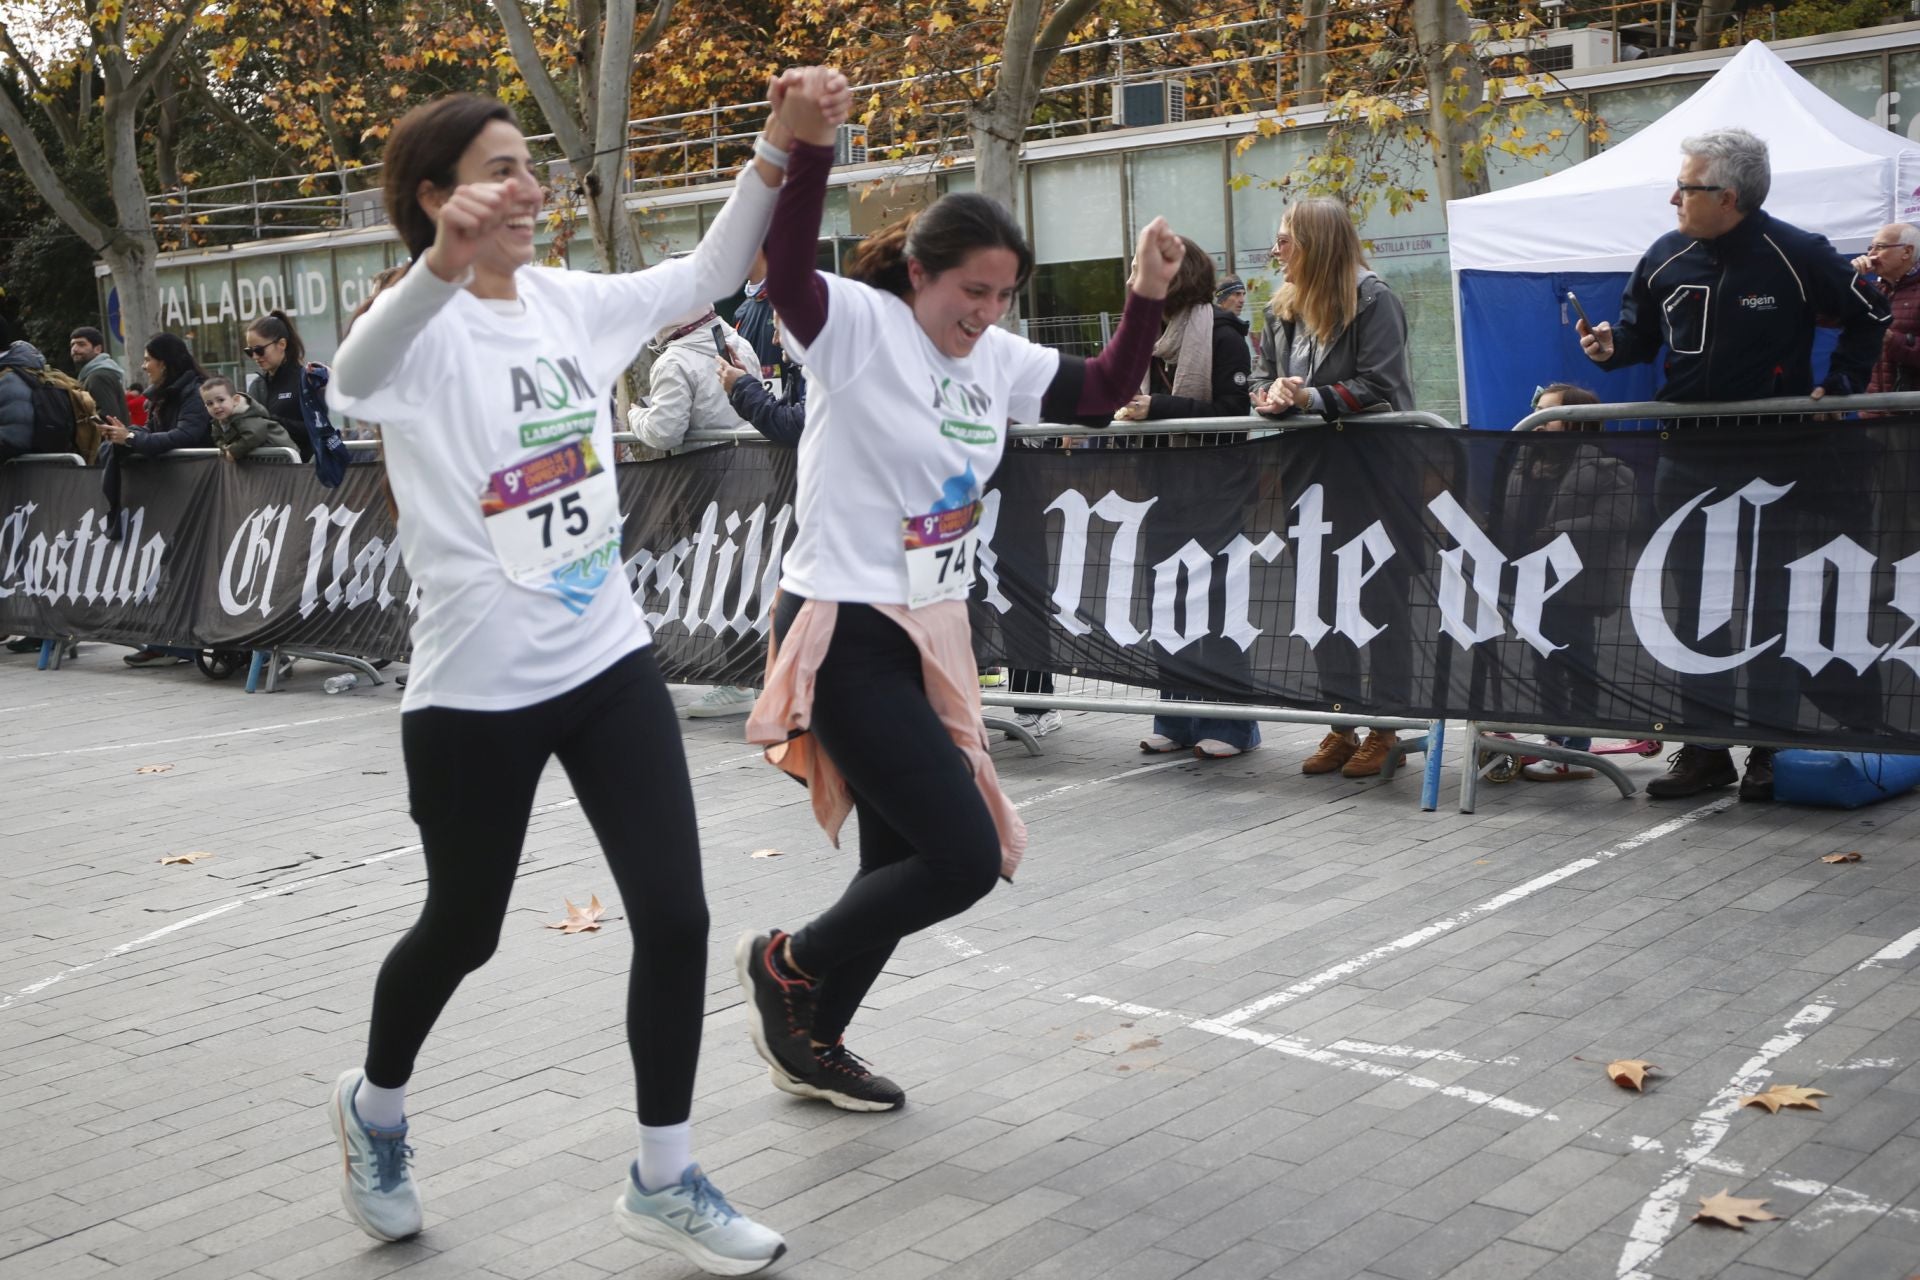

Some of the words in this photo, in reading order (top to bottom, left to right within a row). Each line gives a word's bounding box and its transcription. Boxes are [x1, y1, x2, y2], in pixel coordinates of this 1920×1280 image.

[1374, 240, 1404, 253] ASTILLA
[158, 271, 326, 328] ALLADOLID
[341, 266, 373, 312] ci
[527, 491, 589, 548] 75
[219, 503, 292, 618] El
[622, 501, 793, 640] astill
[935, 539, 966, 584] 74
[1043, 483, 1396, 655] Norte
[1427, 490, 1583, 659] de
